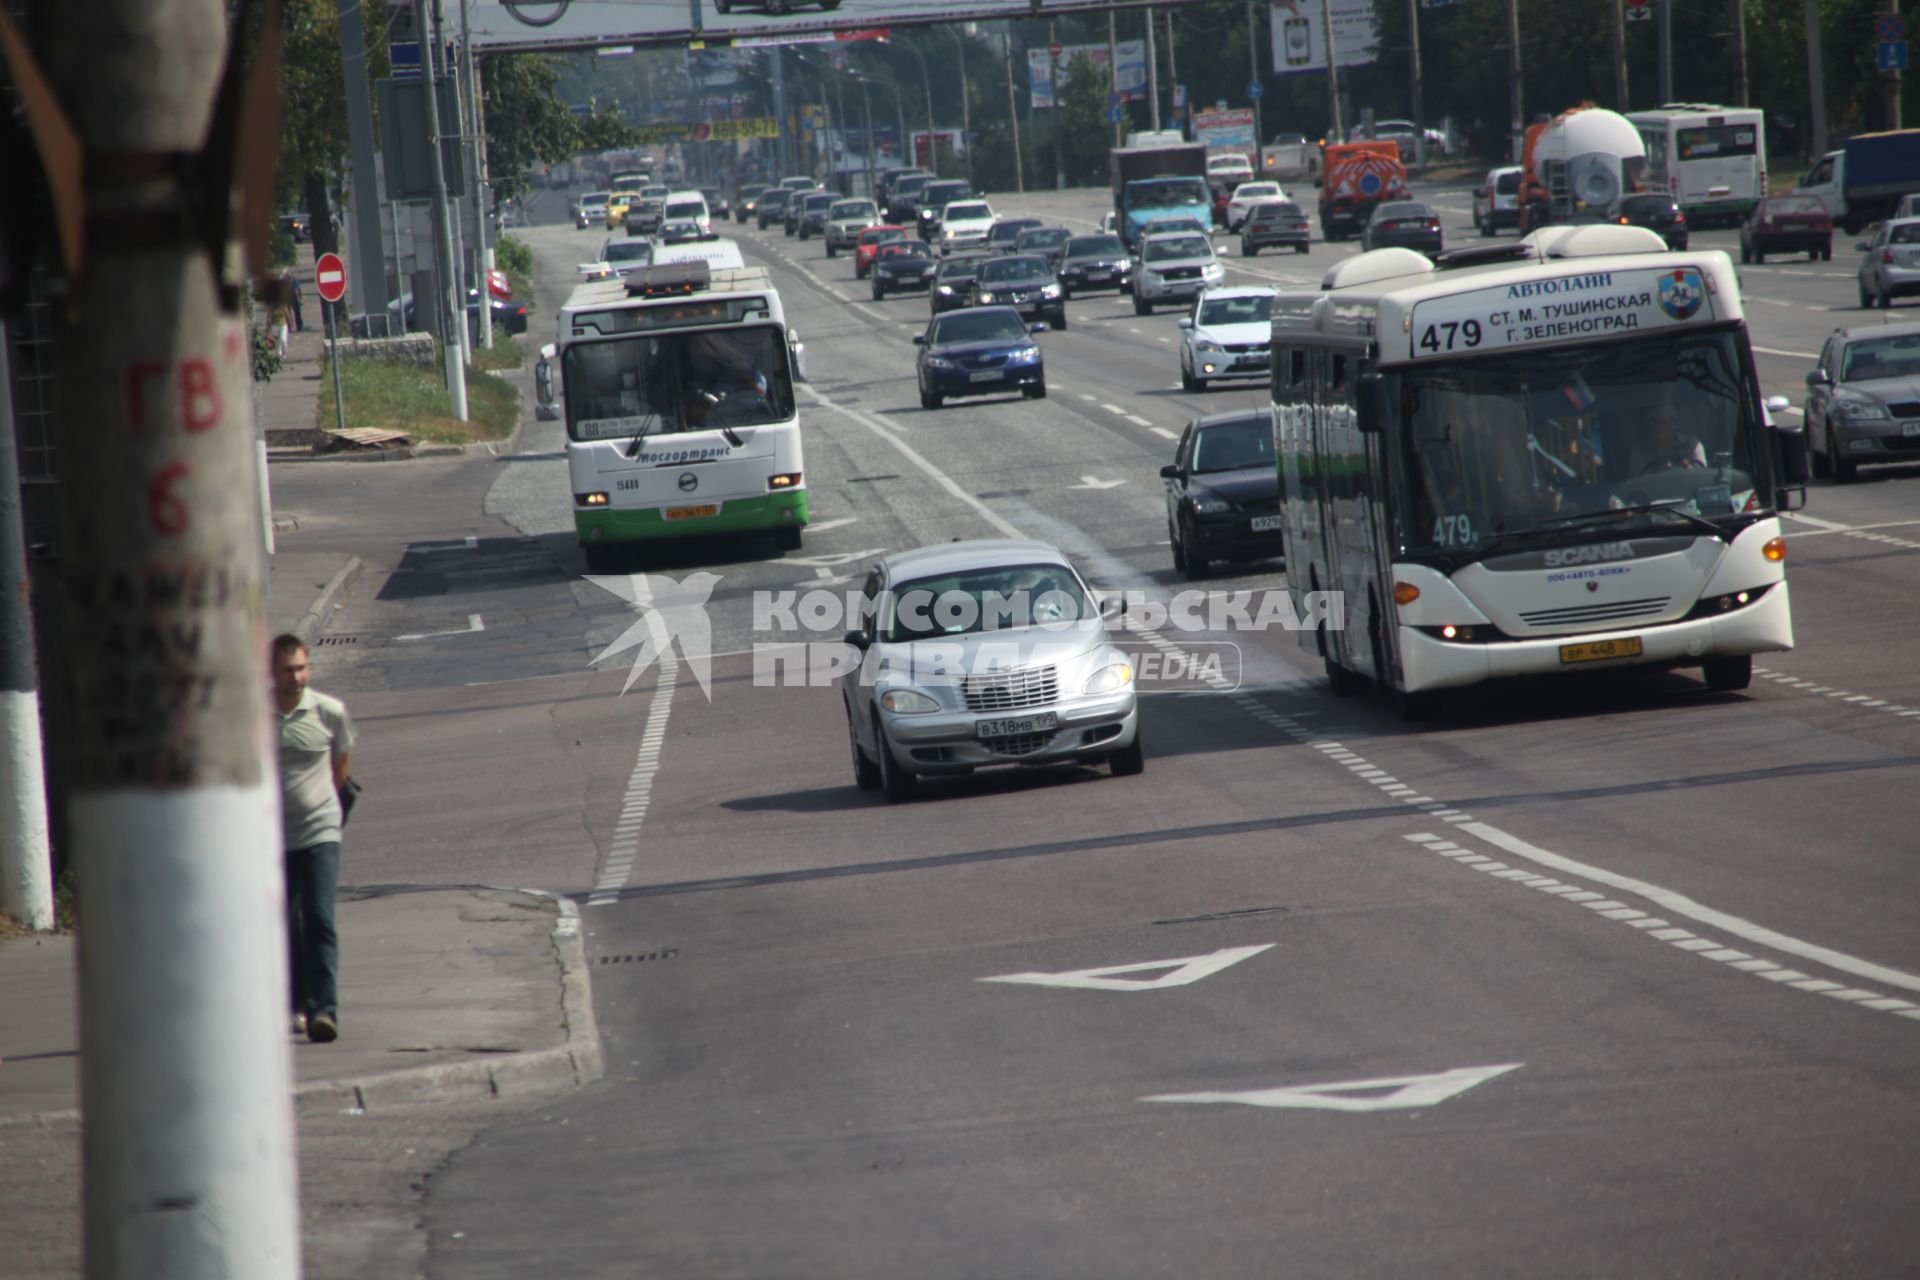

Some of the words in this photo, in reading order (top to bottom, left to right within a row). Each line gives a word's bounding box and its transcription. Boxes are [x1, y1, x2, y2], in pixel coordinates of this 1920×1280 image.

[1489, 311, 1514, 326] СТ.
[1519, 309, 1537, 322] М.
[1542, 292, 1651, 318] ТУШИНСКАЯ
[1420, 319, 1482, 353] 479
[1507, 328, 1518, 342] Г.
[1524, 313, 1638, 340] ЗЕЛЕНОГРАД
[1544, 543, 1634, 566] SCANIA
